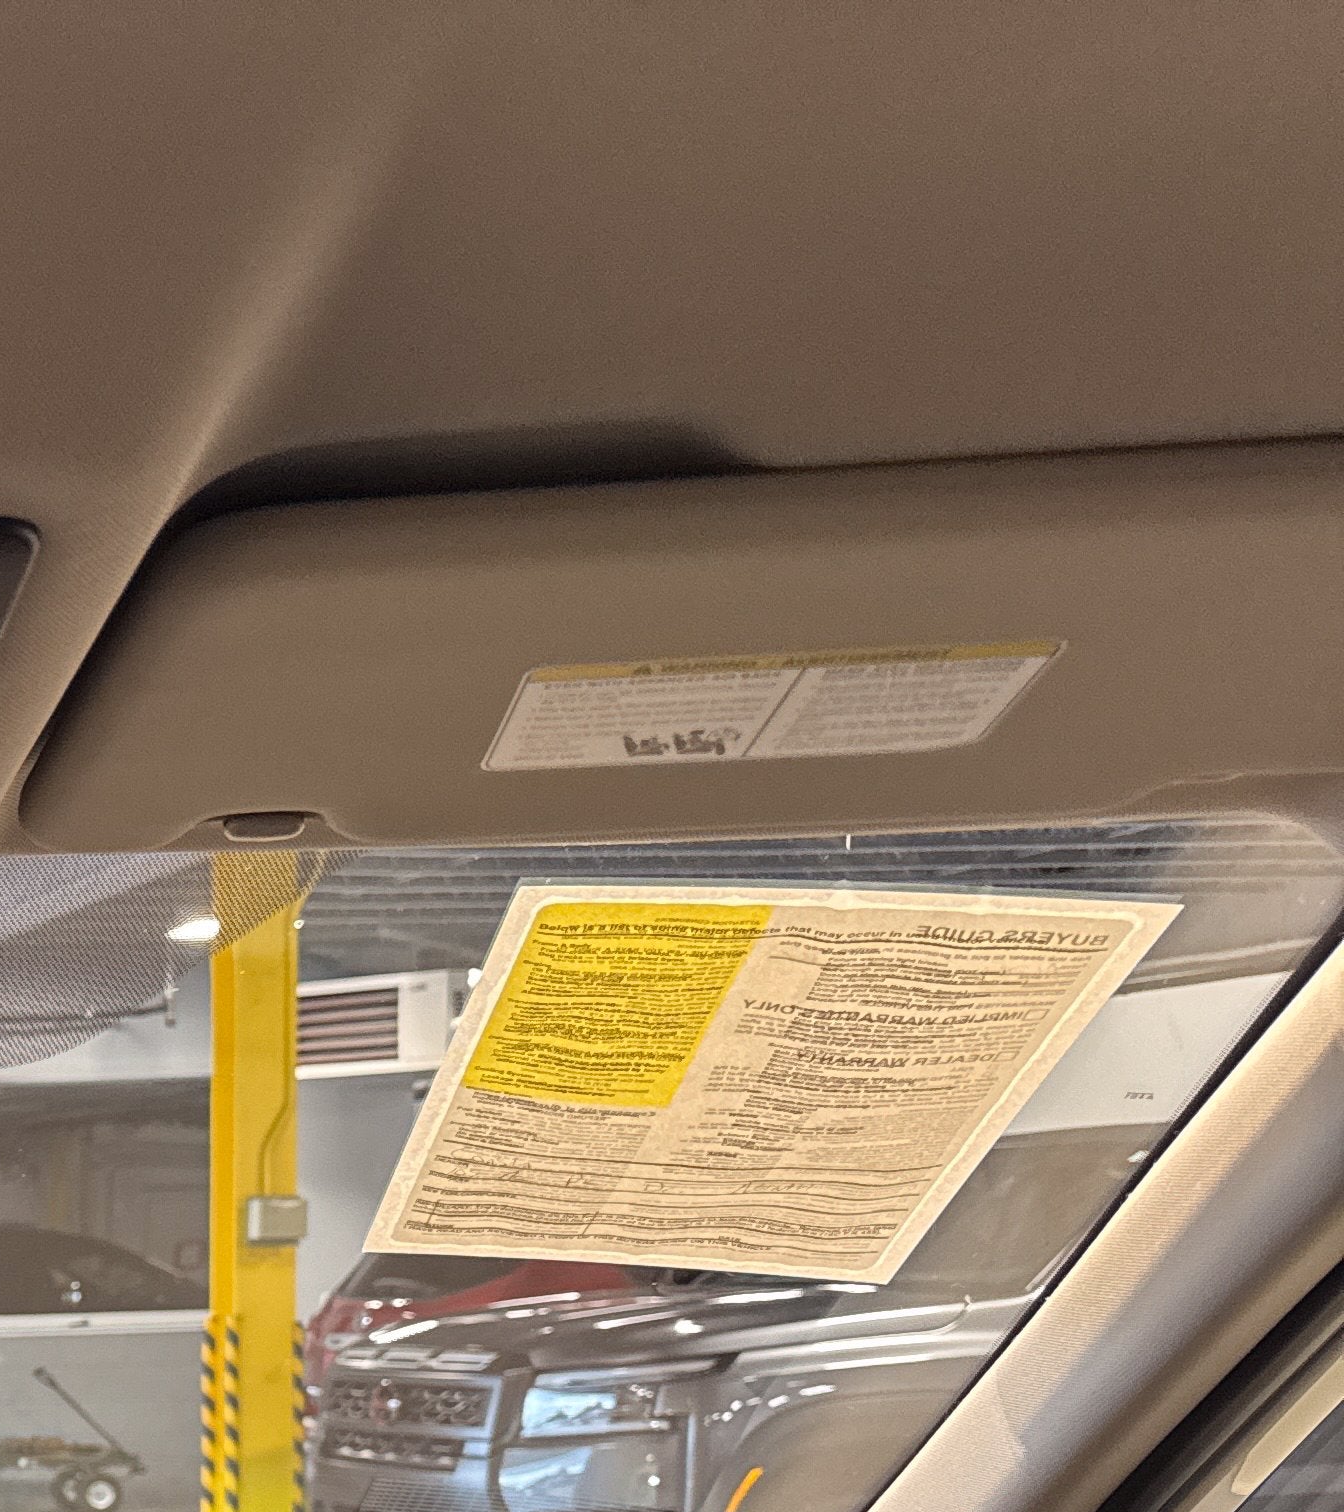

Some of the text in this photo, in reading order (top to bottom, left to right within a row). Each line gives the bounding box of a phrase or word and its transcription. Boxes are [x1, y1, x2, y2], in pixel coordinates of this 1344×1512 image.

[785, 926, 813, 934] that
[815, 930, 843, 940] may
[847, 930, 887, 939] occur
[889, 929, 902, 938] in
